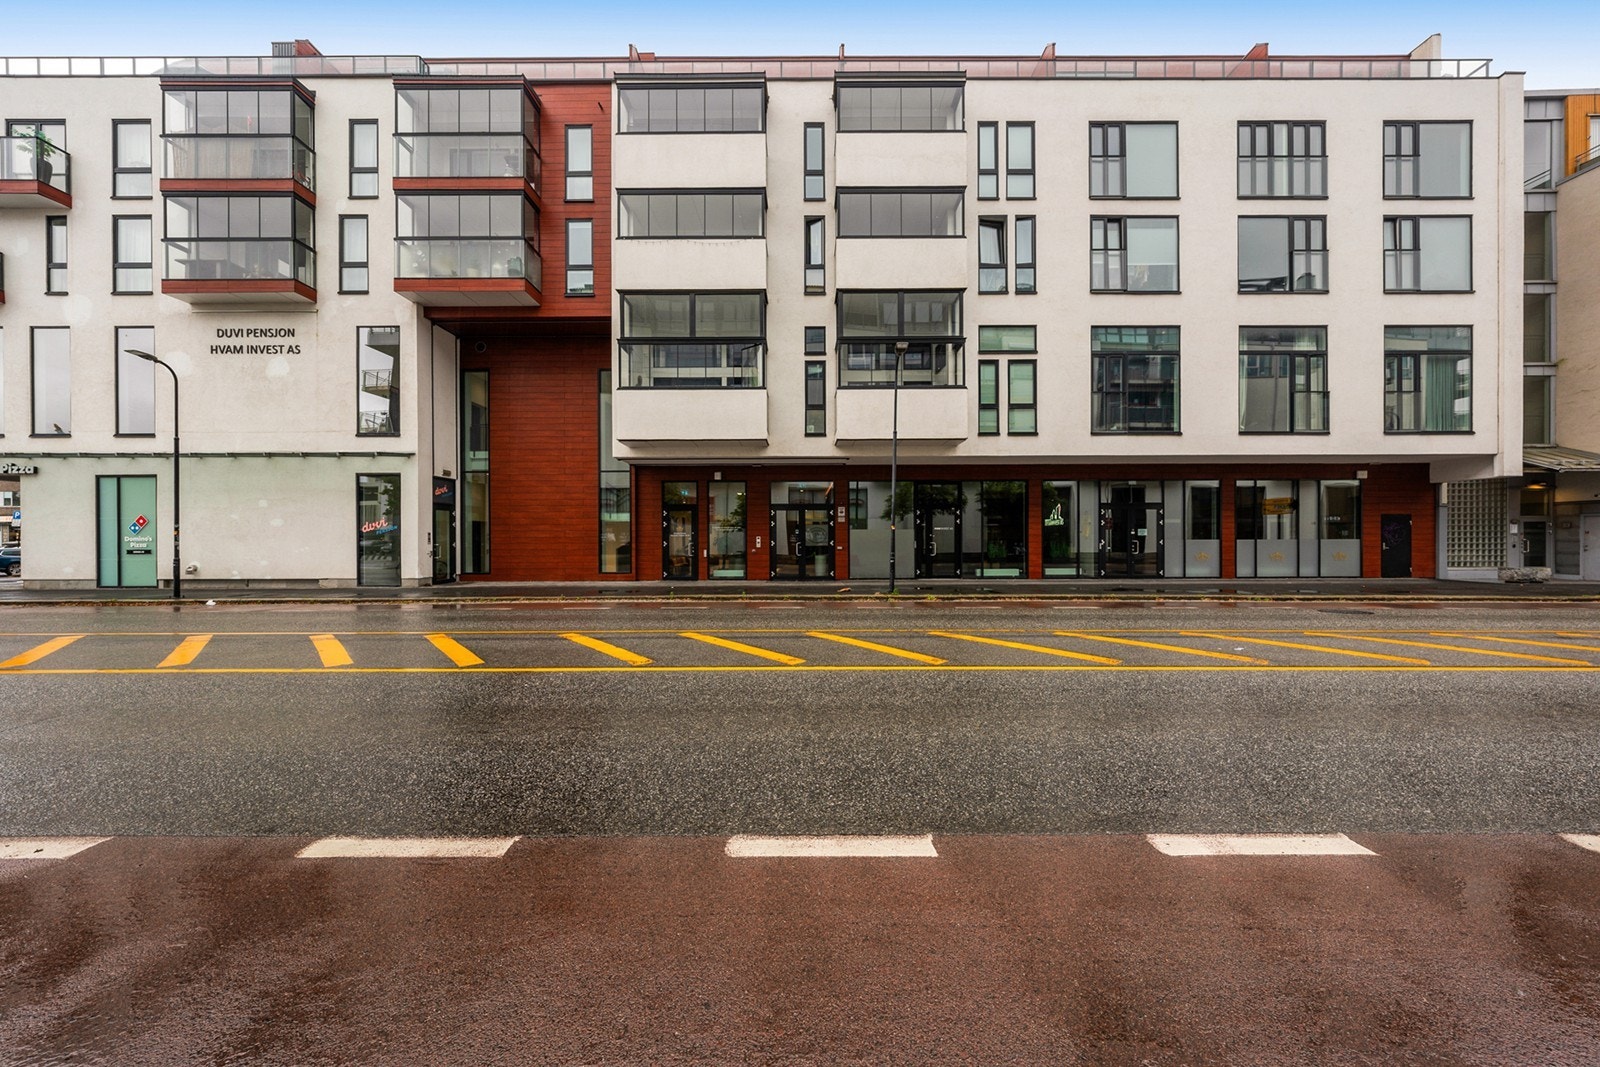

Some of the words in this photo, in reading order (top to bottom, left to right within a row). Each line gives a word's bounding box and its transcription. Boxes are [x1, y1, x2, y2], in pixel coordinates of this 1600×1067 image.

[216, 328, 244, 338] DUVI
[246, 328, 295, 338] PENSJON
[210, 344, 244, 354] HVAM
[246, 344, 285, 354] INVEST
[286, 344, 301, 354] AS
[1, 464, 34, 474] Pizza
